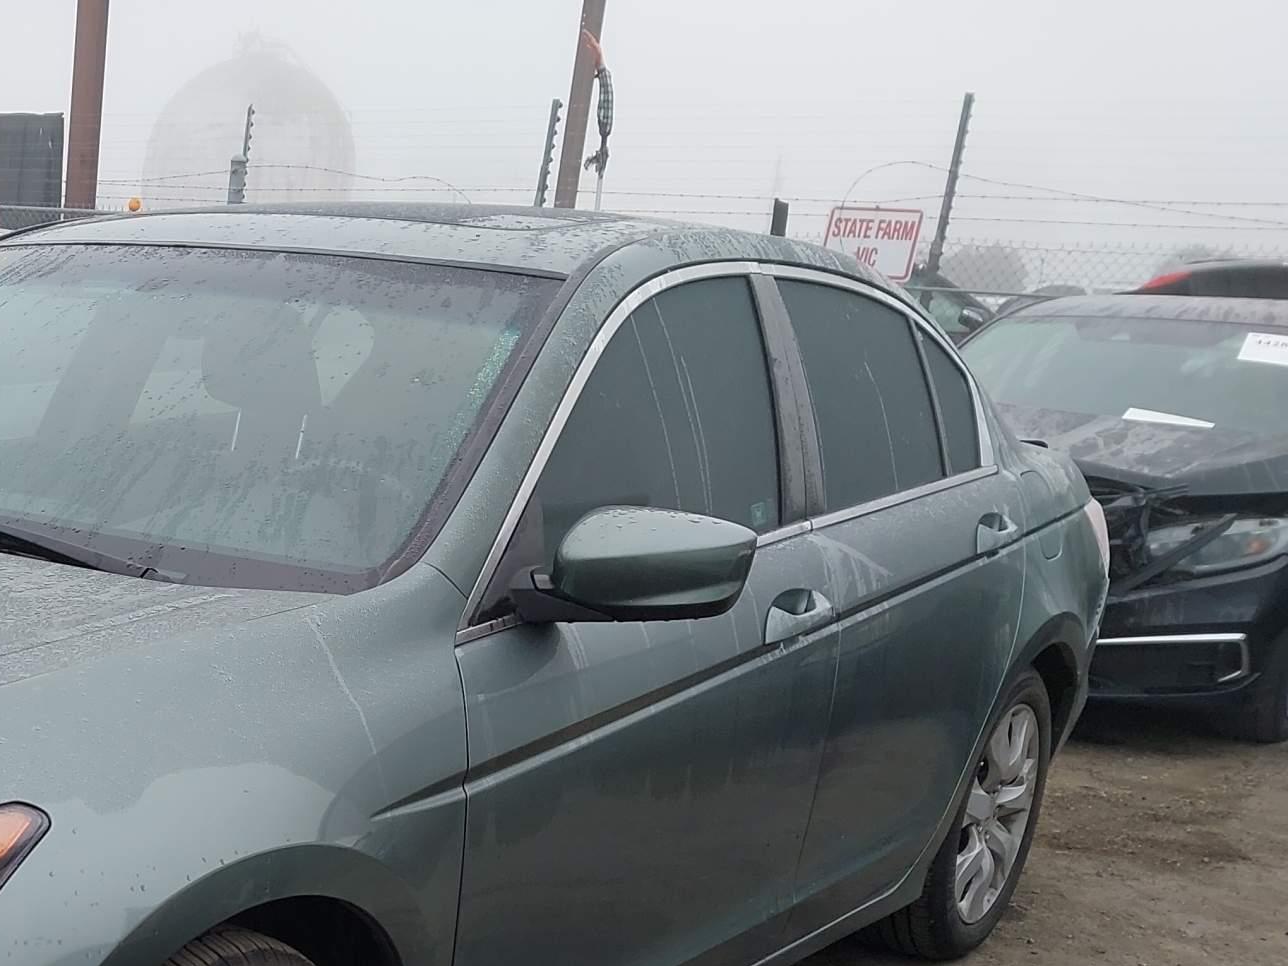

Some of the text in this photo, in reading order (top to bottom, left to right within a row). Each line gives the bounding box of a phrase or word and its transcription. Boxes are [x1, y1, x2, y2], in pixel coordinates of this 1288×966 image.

[832, 217, 916, 241] STATE FARM
[856, 246, 878, 267] VIC
